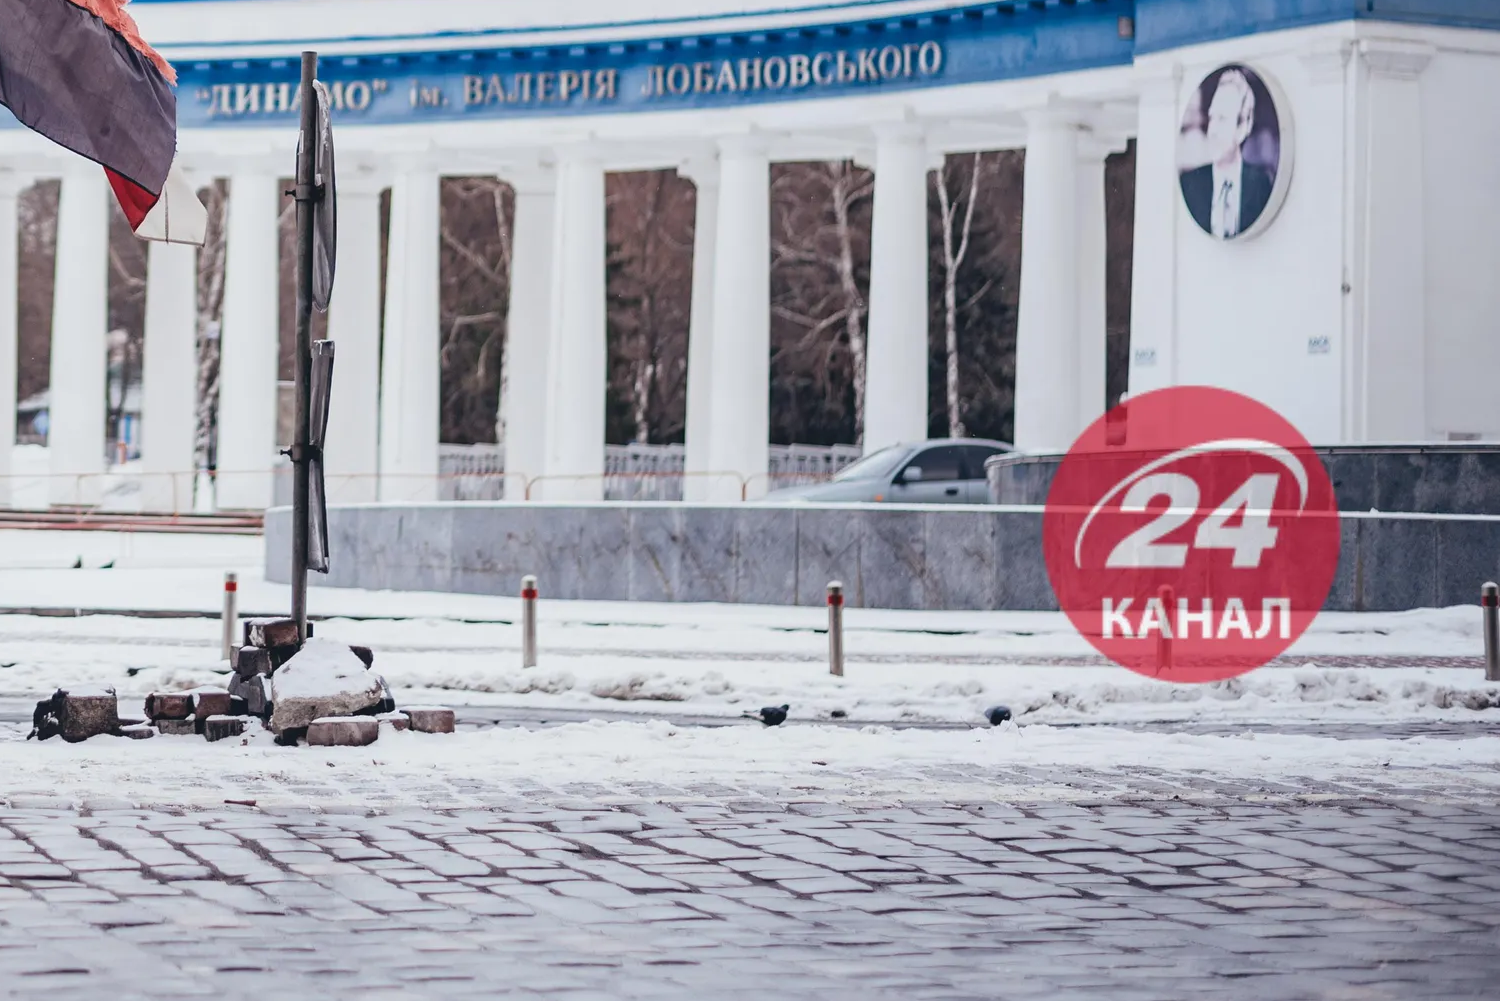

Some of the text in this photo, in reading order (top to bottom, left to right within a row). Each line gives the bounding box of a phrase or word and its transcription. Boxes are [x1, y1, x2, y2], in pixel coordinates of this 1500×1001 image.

[408, 78, 449, 108] ім.
[463, 67, 618, 106] ВАЛЕРІЯ
[640, 40, 942, 97] ЛОБАНОВСЬКОГО
